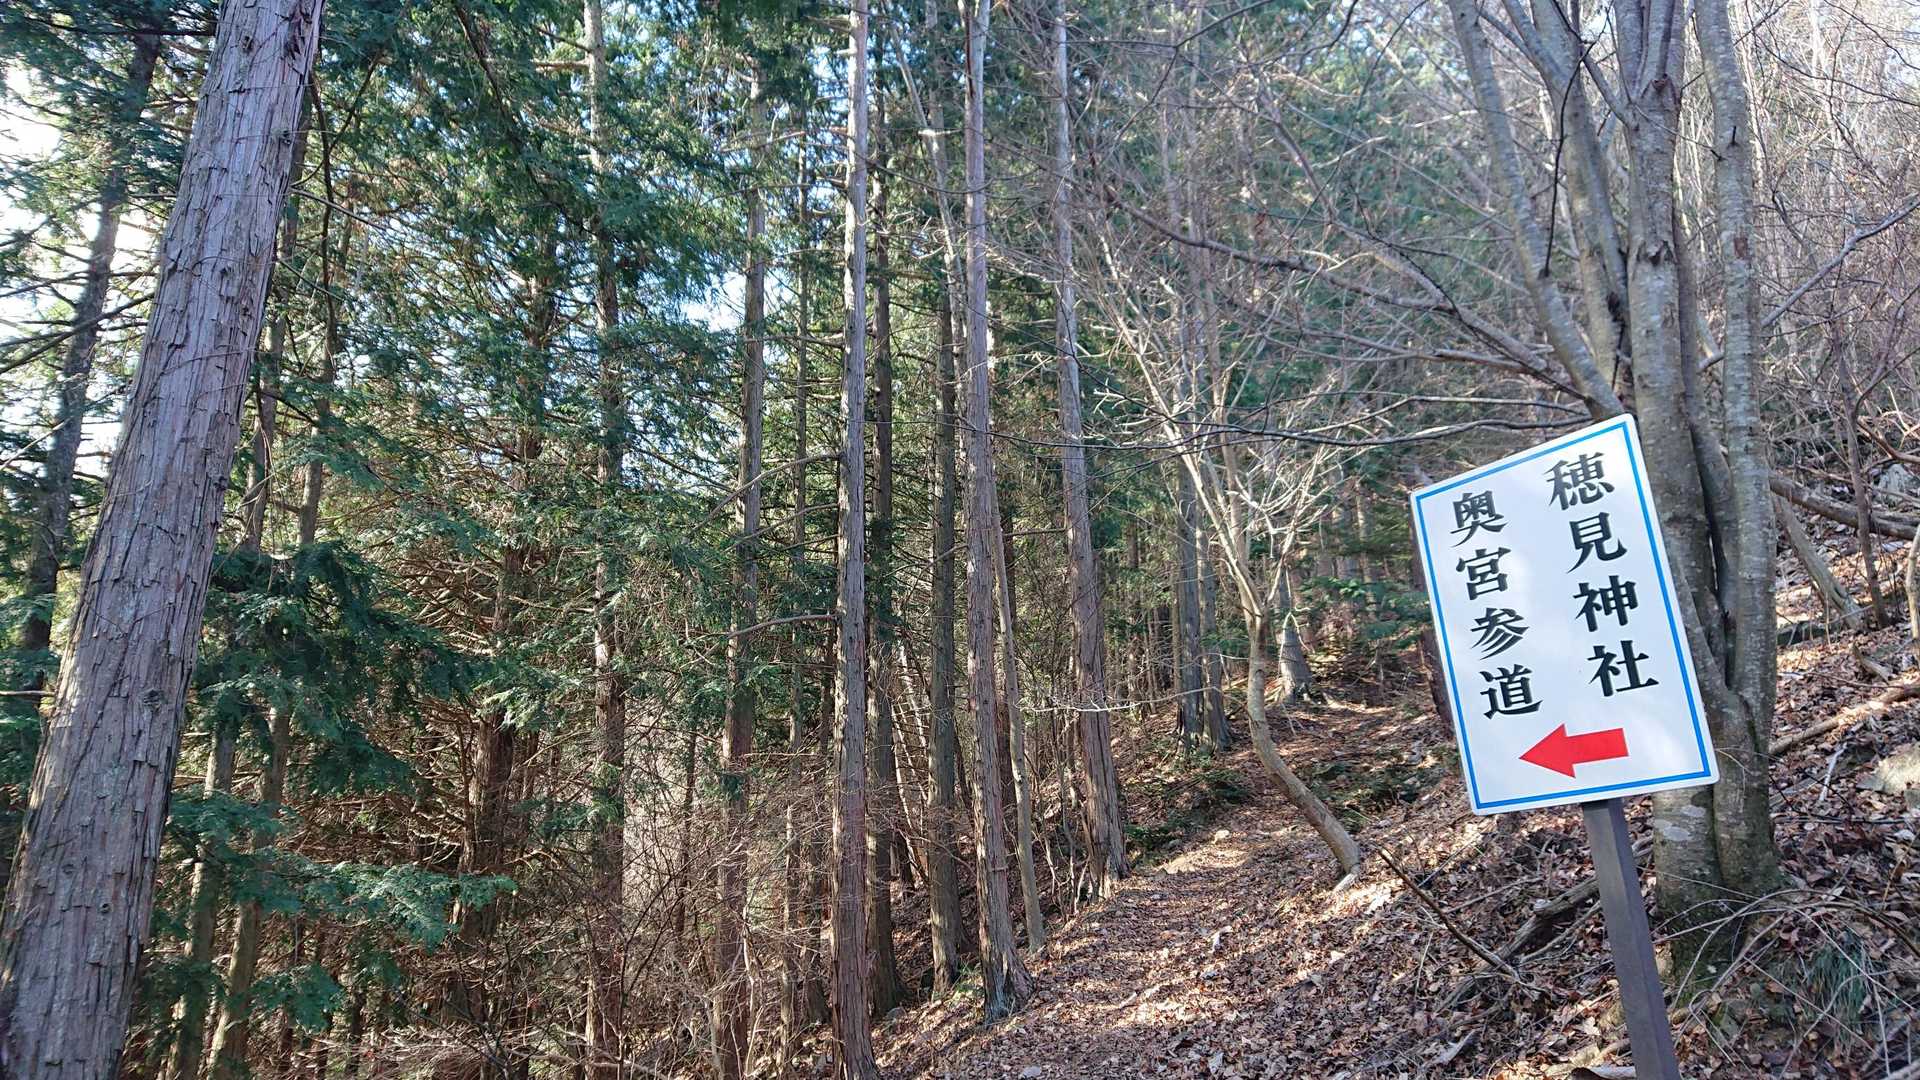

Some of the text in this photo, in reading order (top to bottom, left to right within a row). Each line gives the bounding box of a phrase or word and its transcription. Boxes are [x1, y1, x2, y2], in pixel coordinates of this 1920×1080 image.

[1450, 489, 1543, 719] 奥宮参道
[1544, 451, 1659, 697] 穂見神社
